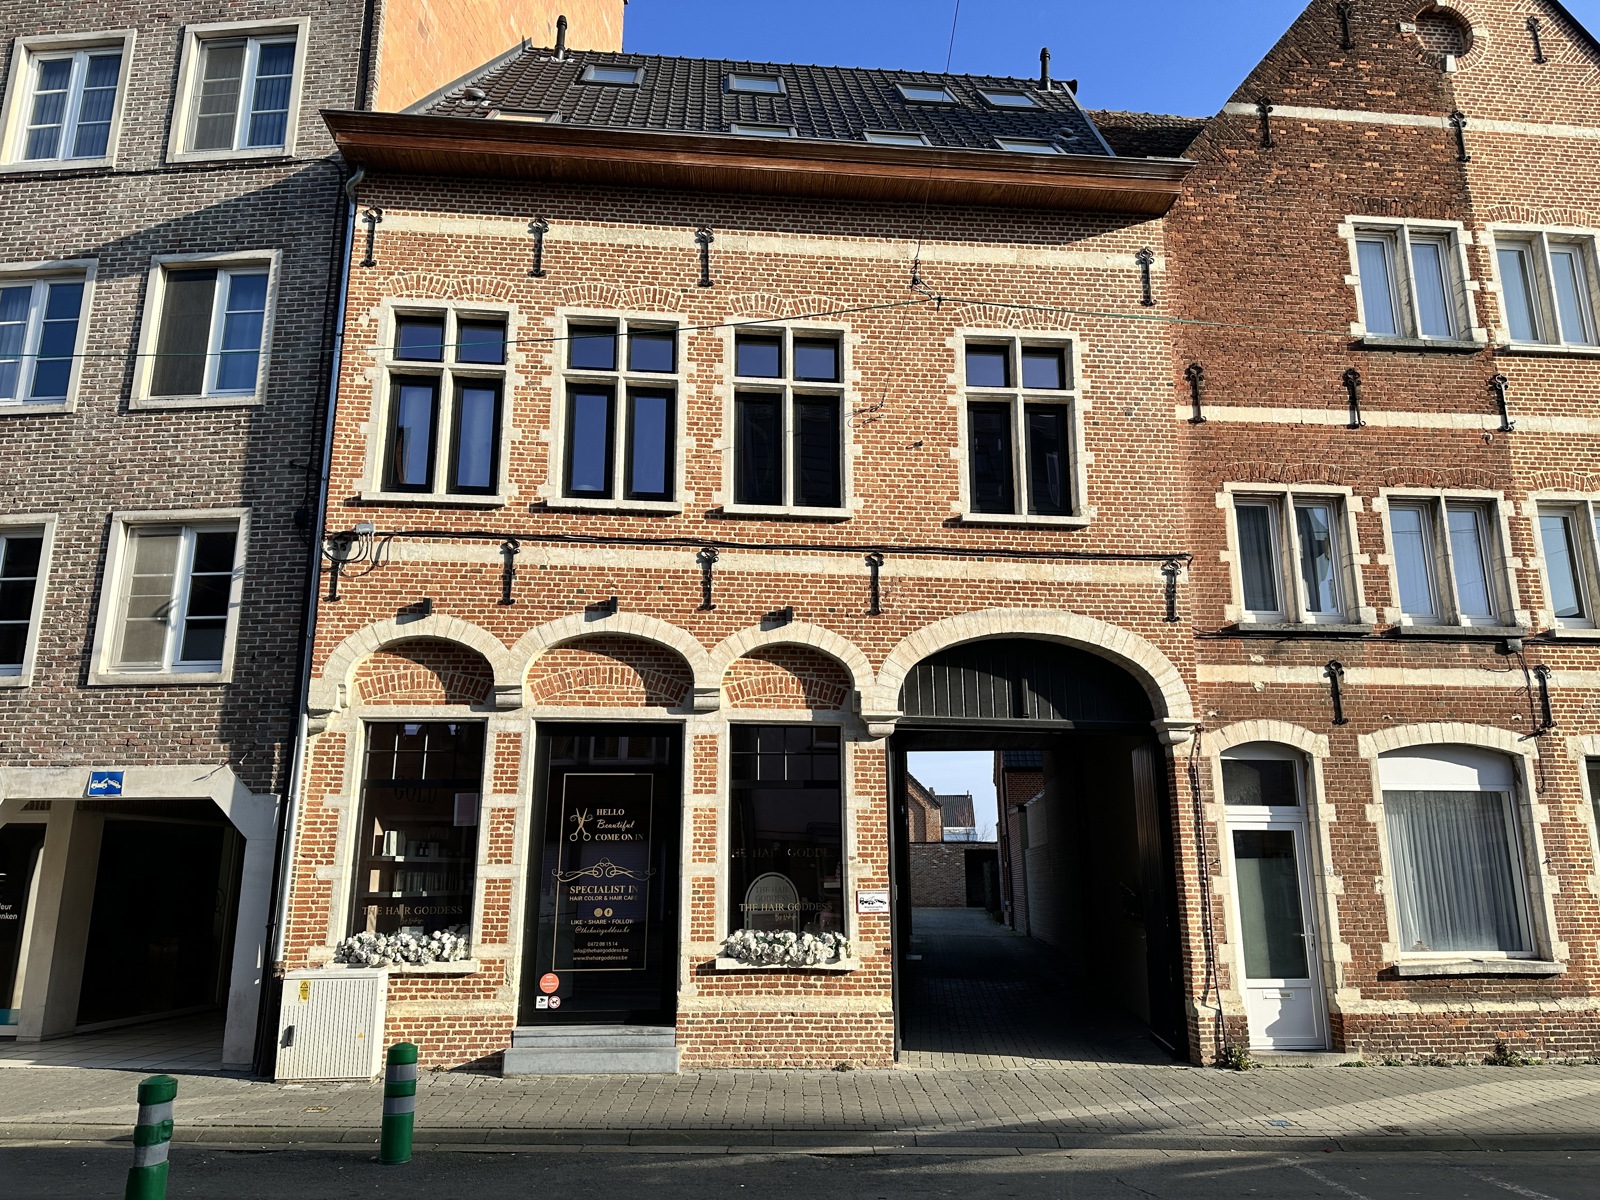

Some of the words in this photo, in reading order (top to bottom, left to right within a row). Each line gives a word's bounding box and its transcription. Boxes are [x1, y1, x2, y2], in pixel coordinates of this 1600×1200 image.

[596, 808, 625, 816] HELLO
[596, 818, 636, 832] Beautiful
[595, 833, 620, 842] COME
[621, 833, 634, 841] ON
[634, 833, 644, 841] IN
[569, 885, 626, 894] SPECIALIST
[628, 885, 639, 894] IN
[755, 886, 770, 894] THE
[772, 886, 790, 894] HAIR
[754, 895, 789, 903] GODDESS
[386, 906, 411, 915] HAIR
[414, 905, 463, 915] GODDESS
[738, 903, 758, 912] THE
[761, 903, 784, 912] HAIR
[787, 902, 833, 911] GODDESS
[0, 912, 18, 920] nken
